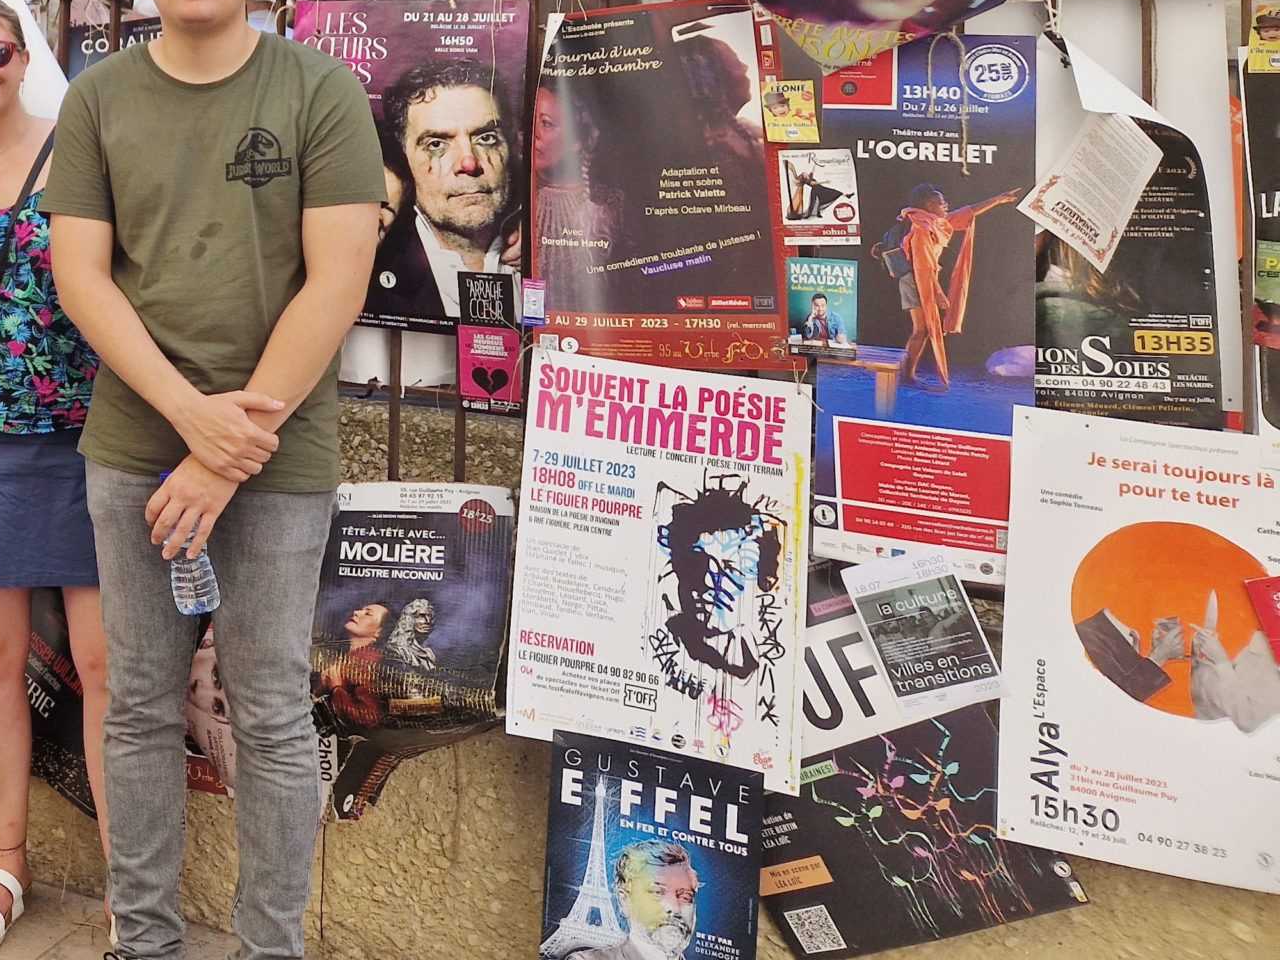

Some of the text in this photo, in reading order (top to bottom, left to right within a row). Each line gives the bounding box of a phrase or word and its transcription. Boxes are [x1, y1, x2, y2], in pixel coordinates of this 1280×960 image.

[324, 11, 367, 36] LES
[403, 12, 515, 23] DU 21 AU 28 JUILLET
[440, 36, 474, 46] 16H50
[552, 45, 653, 65] journal d'une
[579, 60, 663, 77] de chambre
[974, 63, 1000, 83] 25
[770, 84, 807, 93] LÉONIE
[903, 84, 961, 100] 13H40
[856, 139, 998, 165] L'OGRELET
[255, 161, 289, 175] WORLD
[661, 166, 719, 178] Adaptation et
[659, 188, 726, 199] Patrick Valette
[541, 236, 609, 249] Dorothée Hardy
[790, 263, 855, 277] NATHAN
[790, 274, 855, 287] CHAUDAT
[592, 318, 721, 329] JUILLET 2023 17H30
[1135, 333, 1213, 353] 13H35
[1081, 334, 1171, 378] SOIES
[539, 363, 786, 424] SOUVENT LA POÉSIE
[536, 389, 784, 466] M'EMMERDE
[533, 449, 636, 479] 7-29 JUILLET 2023
[1087, 452, 1275, 489] Je serai toujours là
[532, 466, 575, 488] 18H08
[1119, 482, 1240, 509] pour te tuer
[341, 526, 446, 540] TÊTE-À-TÊTE AVEC...
[339, 540, 445, 565] MOLIÈRE
[338, 567, 444, 581] L'ILLUSTRE INCONNU
[877, 588, 957, 616] la culture
[520, 629, 595, 656] RÉSERVATION
[890, 655, 959, 678] villes en
[896, 662, 993, 692] transitions
[628, 689, 654, 705] T'OFF
[1033, 658, 1048, 719] L'Espace
[1030, 721, 1068, 793] Alya
[564, 748, 750, 804] GUSTAVE
[1099, 791, 1137, 805] Avignon
[1030, 794, 1120, 832] 15h30
[620, 818, 748, 857] EN FER ET CONTRE TOUS
